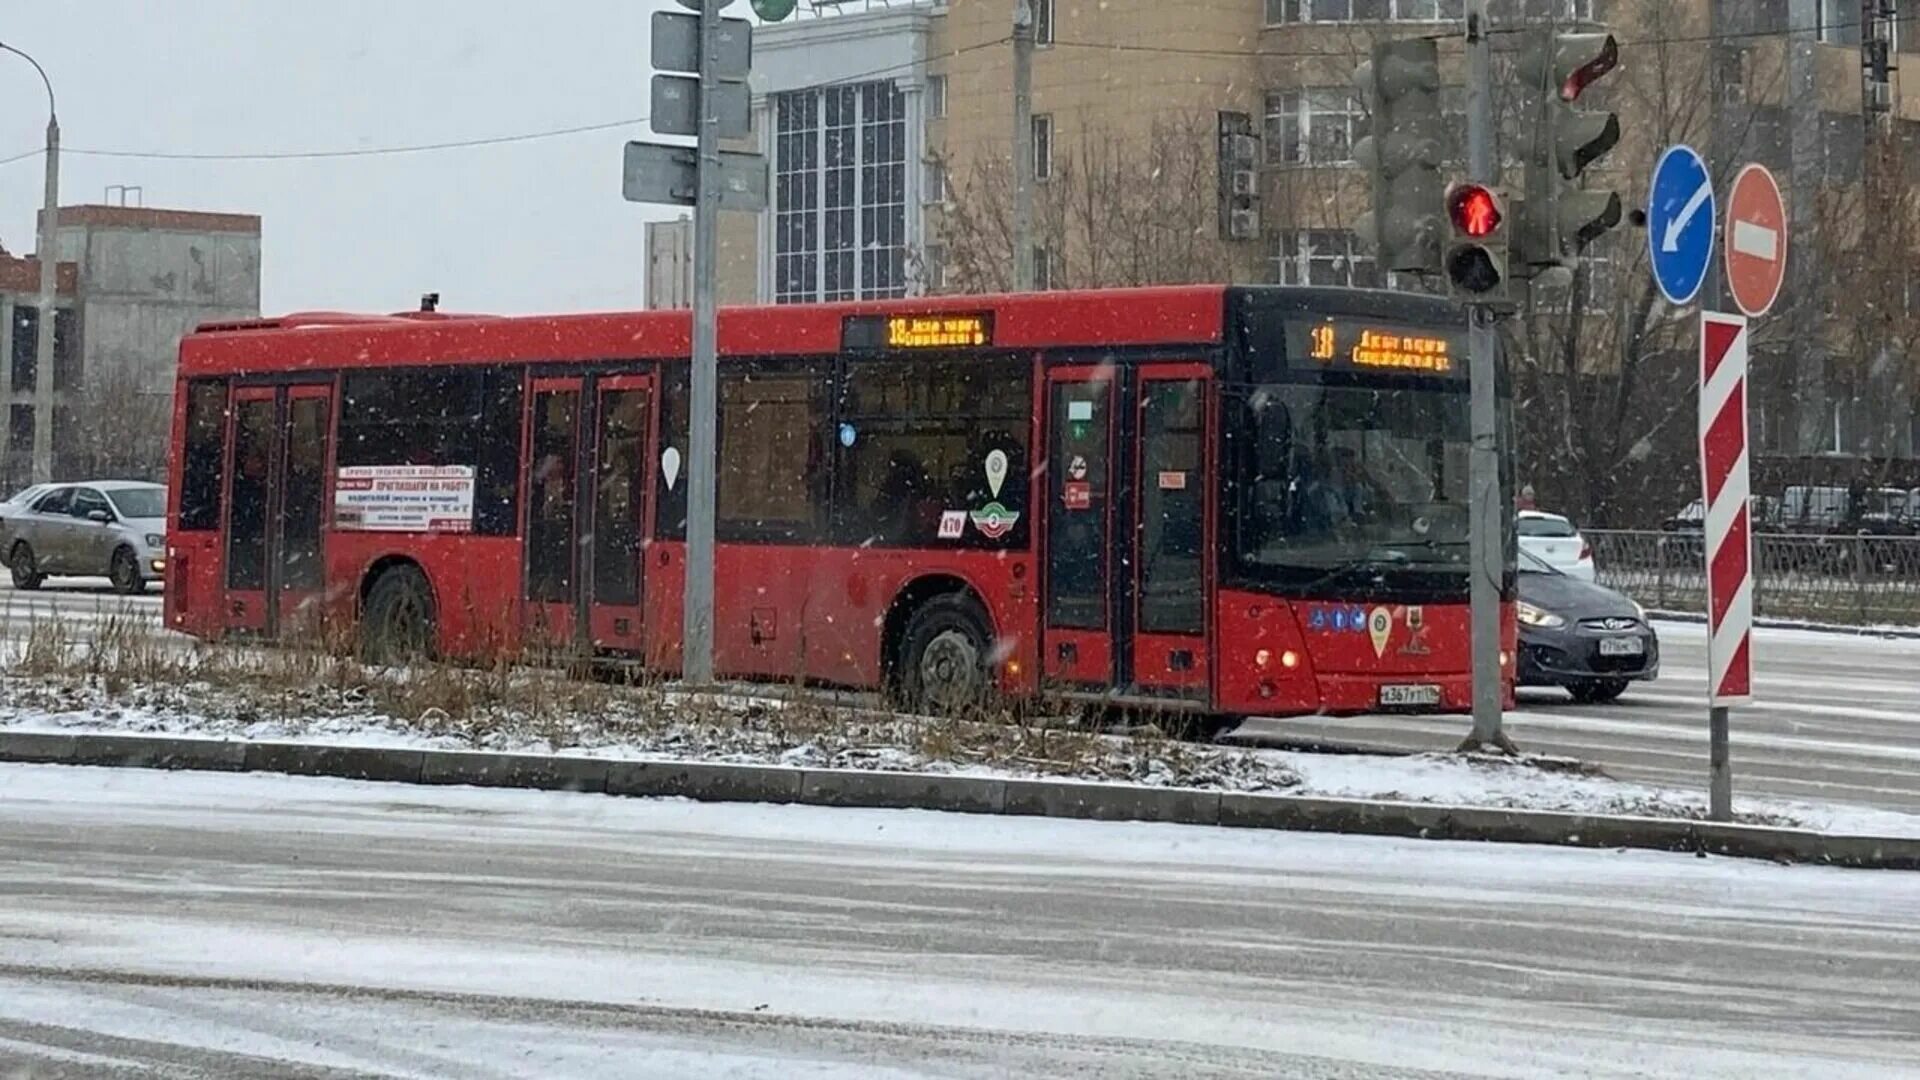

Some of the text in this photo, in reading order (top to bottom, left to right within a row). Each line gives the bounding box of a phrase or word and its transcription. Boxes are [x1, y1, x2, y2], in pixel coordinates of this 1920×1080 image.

[888, 318, 906, 345] 18
[1310, 325, 1334, 360] 18
[942, 517, 962, 534] 470
